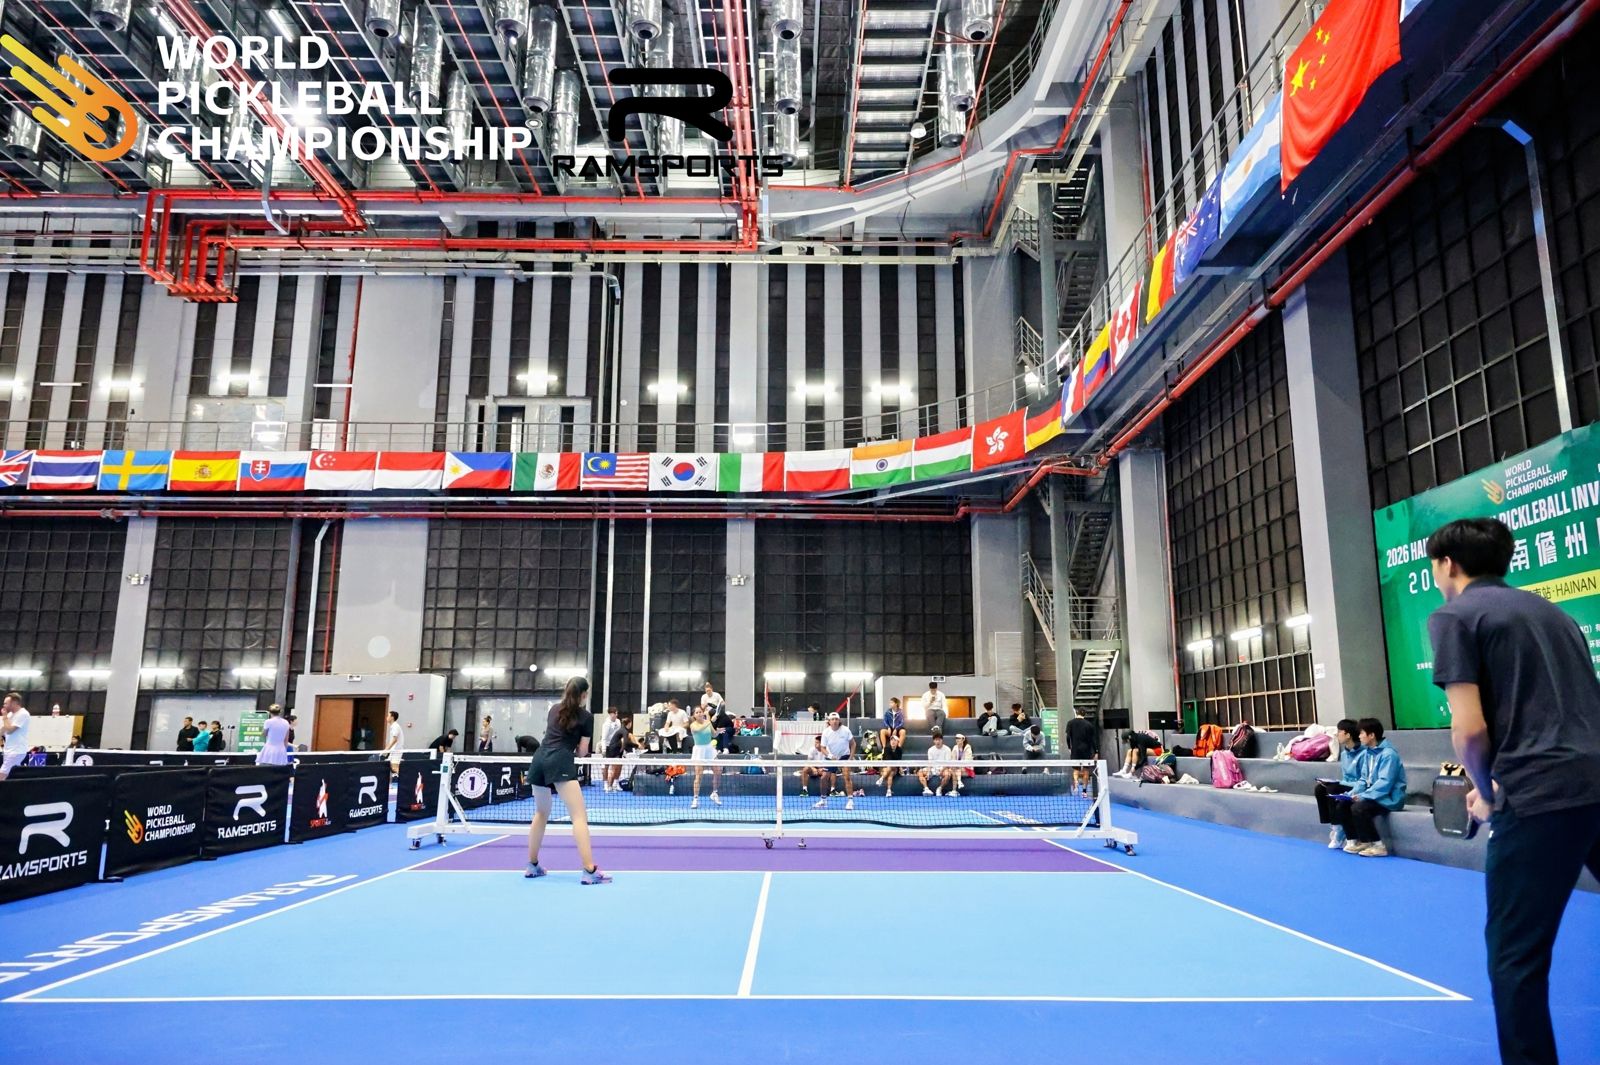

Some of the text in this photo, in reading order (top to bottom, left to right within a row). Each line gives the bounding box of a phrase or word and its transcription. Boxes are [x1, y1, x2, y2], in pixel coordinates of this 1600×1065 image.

[1505, 459, 1532, 478] WORLD
[1505, 463, 1551, 490] PICKLEBALL
[1506, 469, 1568, 501] CHAMPIONSHIP
[1386, 543, 1409, 568] 2026
[1499, 491, 1571, 530] PICKLEBALL
[1408, 517, 1600, 594] 20 南儋州
[469, 776, 476, 791] 1
[147, 804, 172, 817] WORLD
[349, 804, 383, 819] RAMSPORTS
[145, 814, 186, 829] PICKLEBALL
[217, 820, 277, 839] RAMSPORTS
[144, 822, 196, 842] CHAMPIONSHIP
